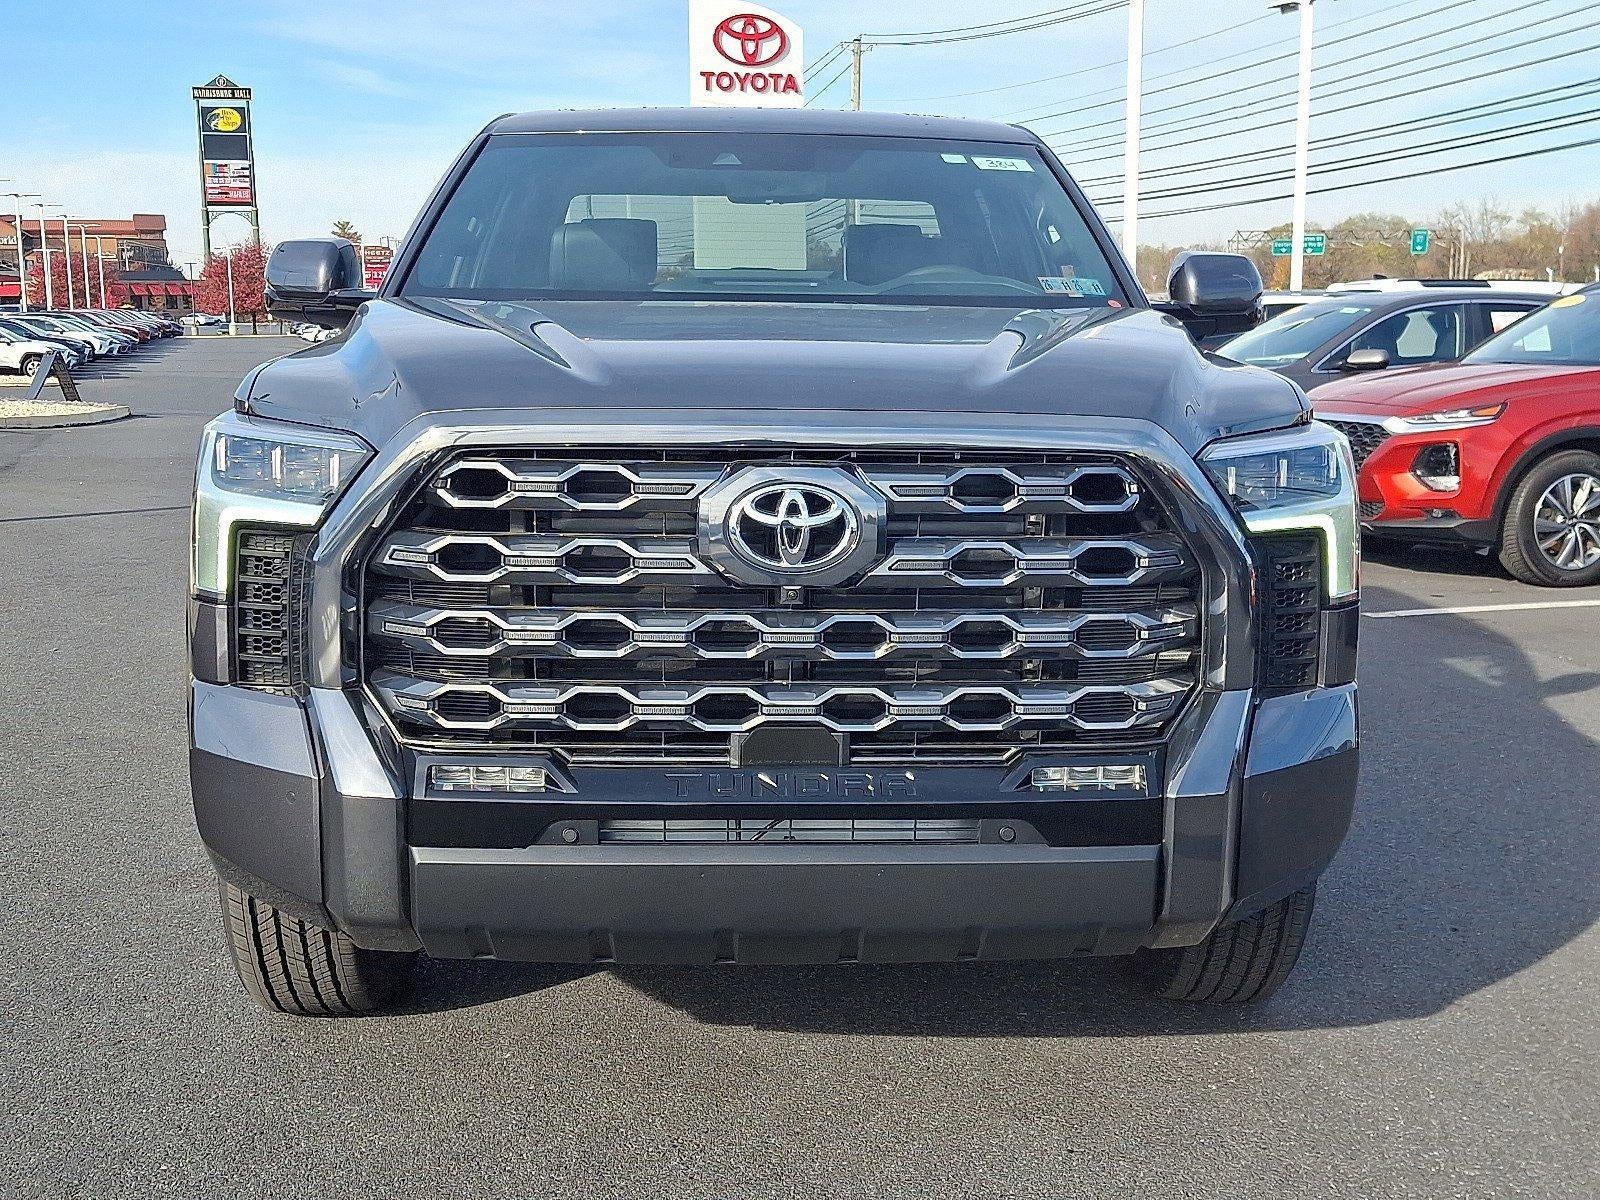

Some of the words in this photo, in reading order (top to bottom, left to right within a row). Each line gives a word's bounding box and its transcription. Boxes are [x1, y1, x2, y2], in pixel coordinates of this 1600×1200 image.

[700, 72, 800, 93] TOYOTA
[0, 235, 17, 244] orld
[665, 772, 917, 797] TUNDRA
